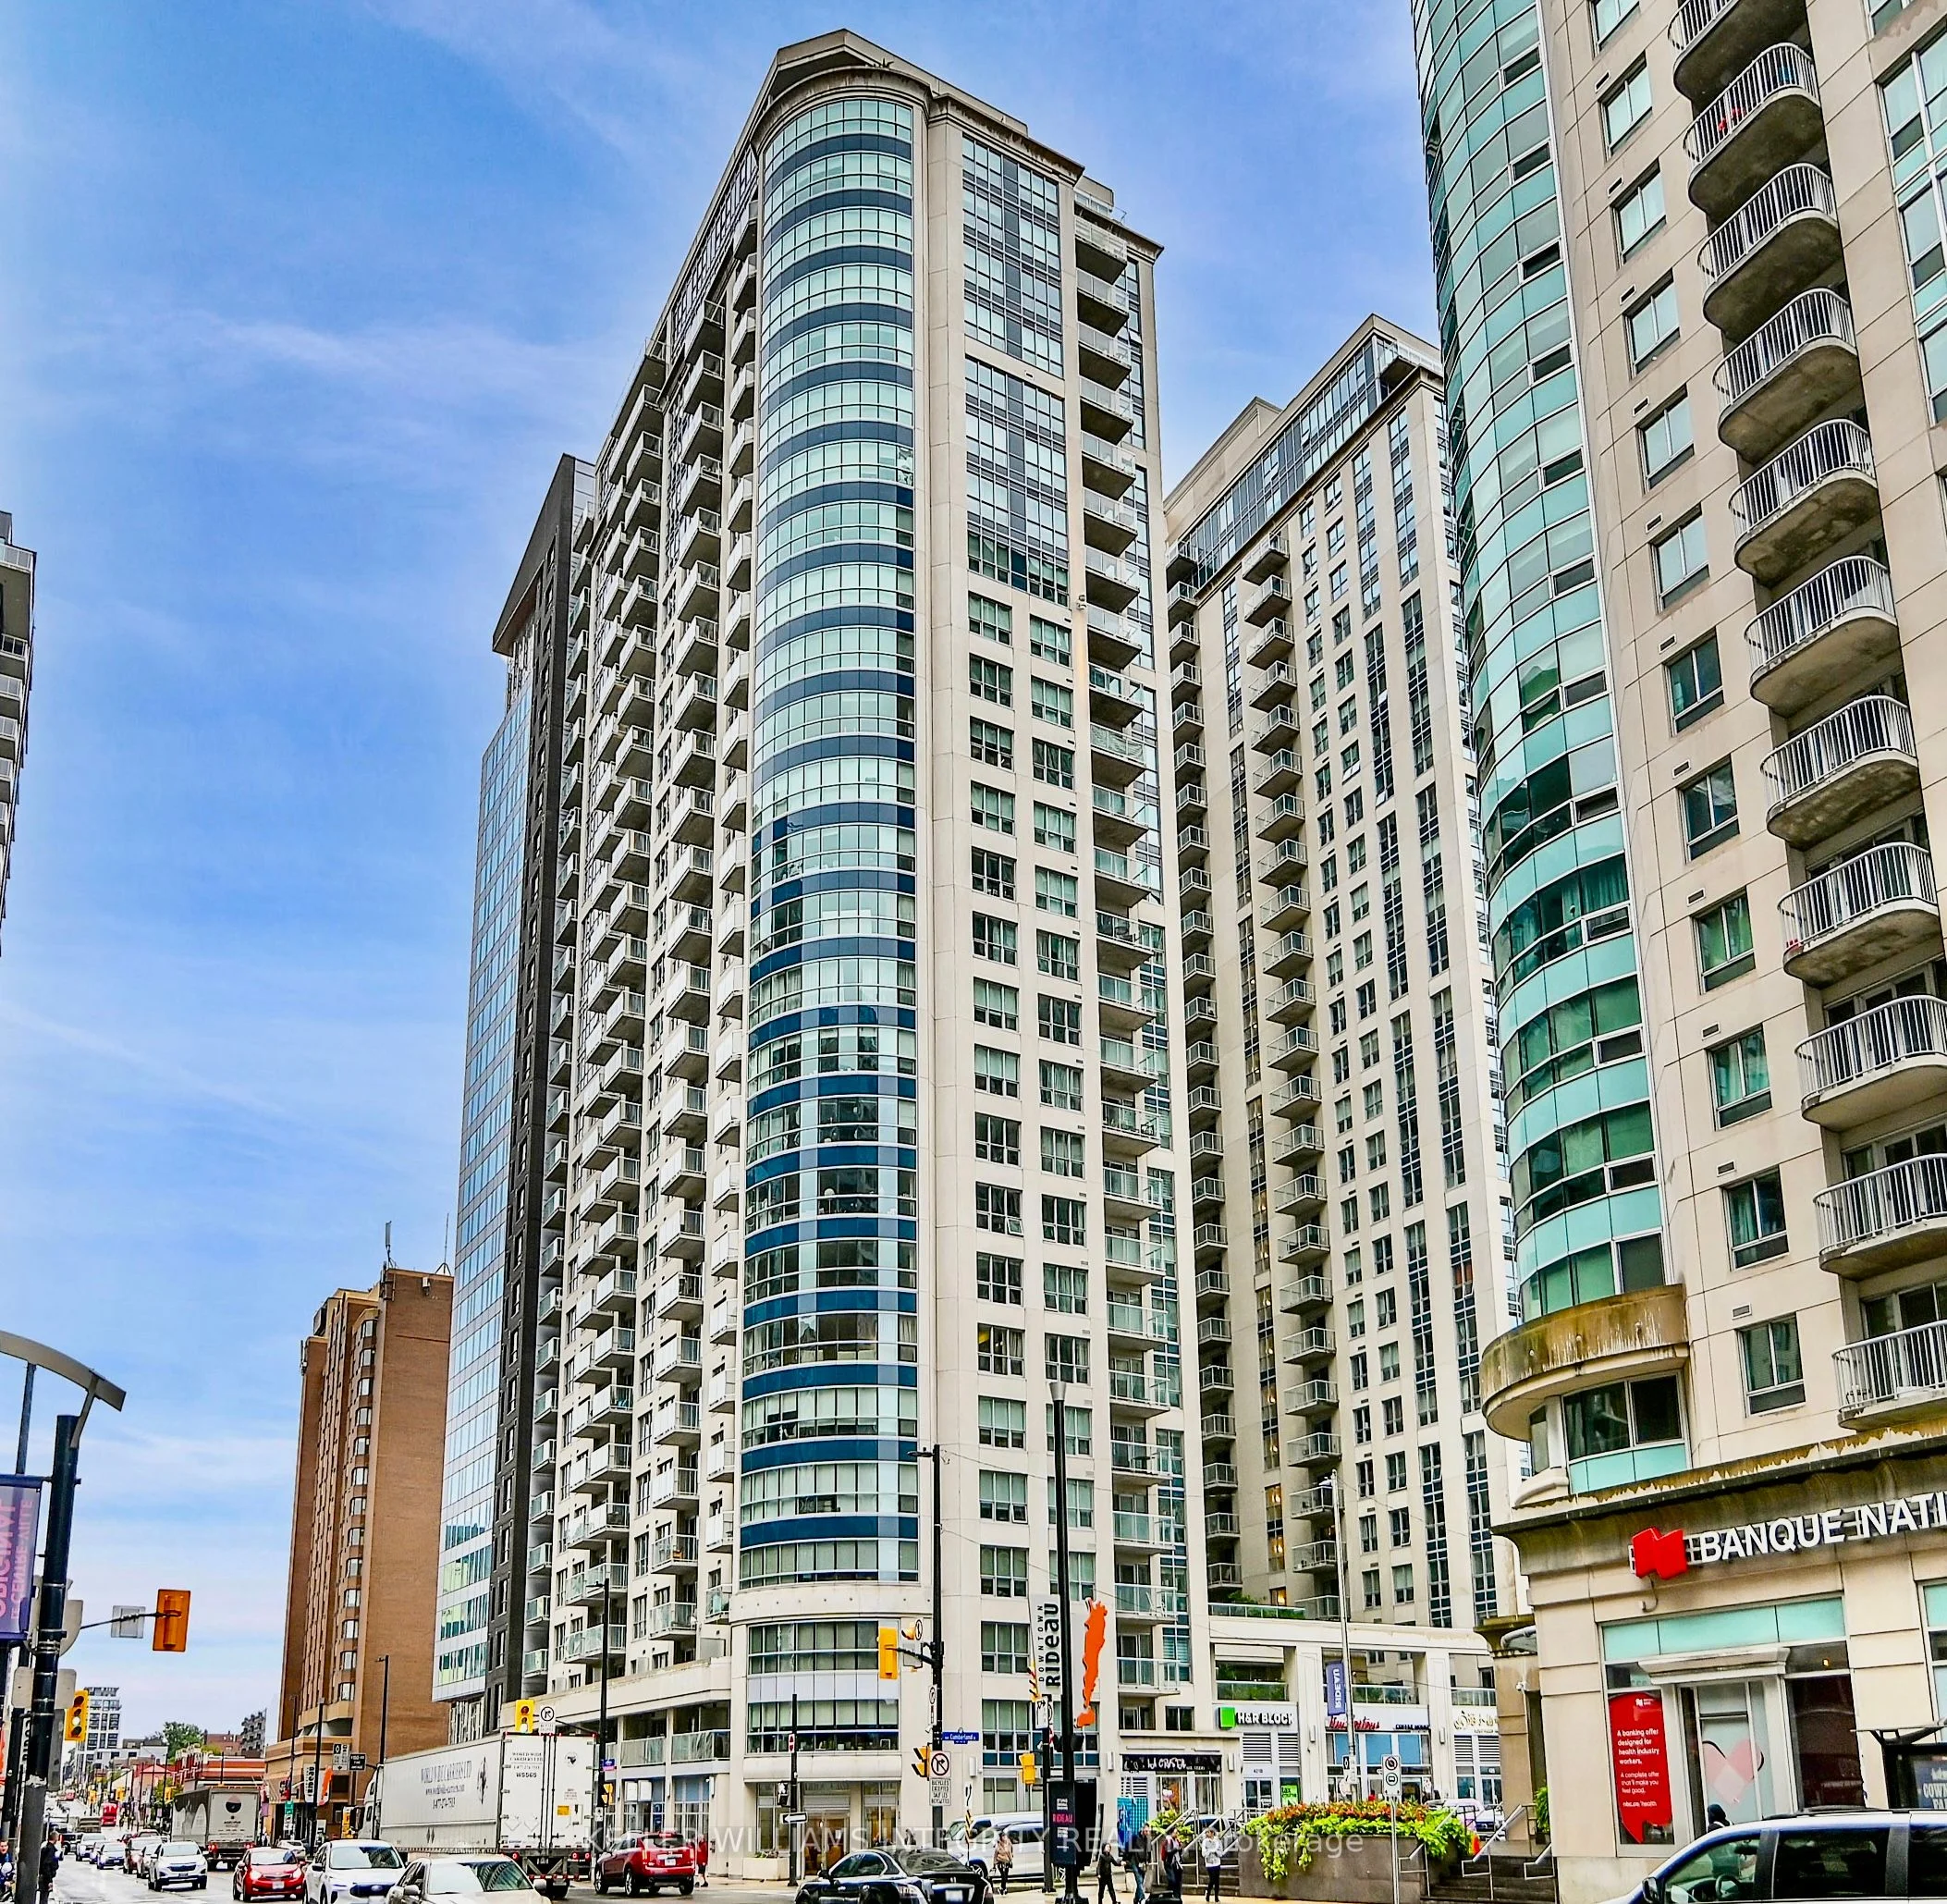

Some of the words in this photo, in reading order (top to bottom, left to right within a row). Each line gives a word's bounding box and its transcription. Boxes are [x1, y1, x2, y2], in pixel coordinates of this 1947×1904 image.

[1699, 1508, 1845, 1564] BANQUE
[1237, 1713, 1259, 1724] H&R
[1261, 1713, 1294, 1725] BLOCK
[1622, 1728, 1645, 1737] banking
[1617, 1738, 1643, 1747] designed
[1636, 1747, 1659, 1755] industry
[1052, 1813, 1072, 1823] RIDEAU
